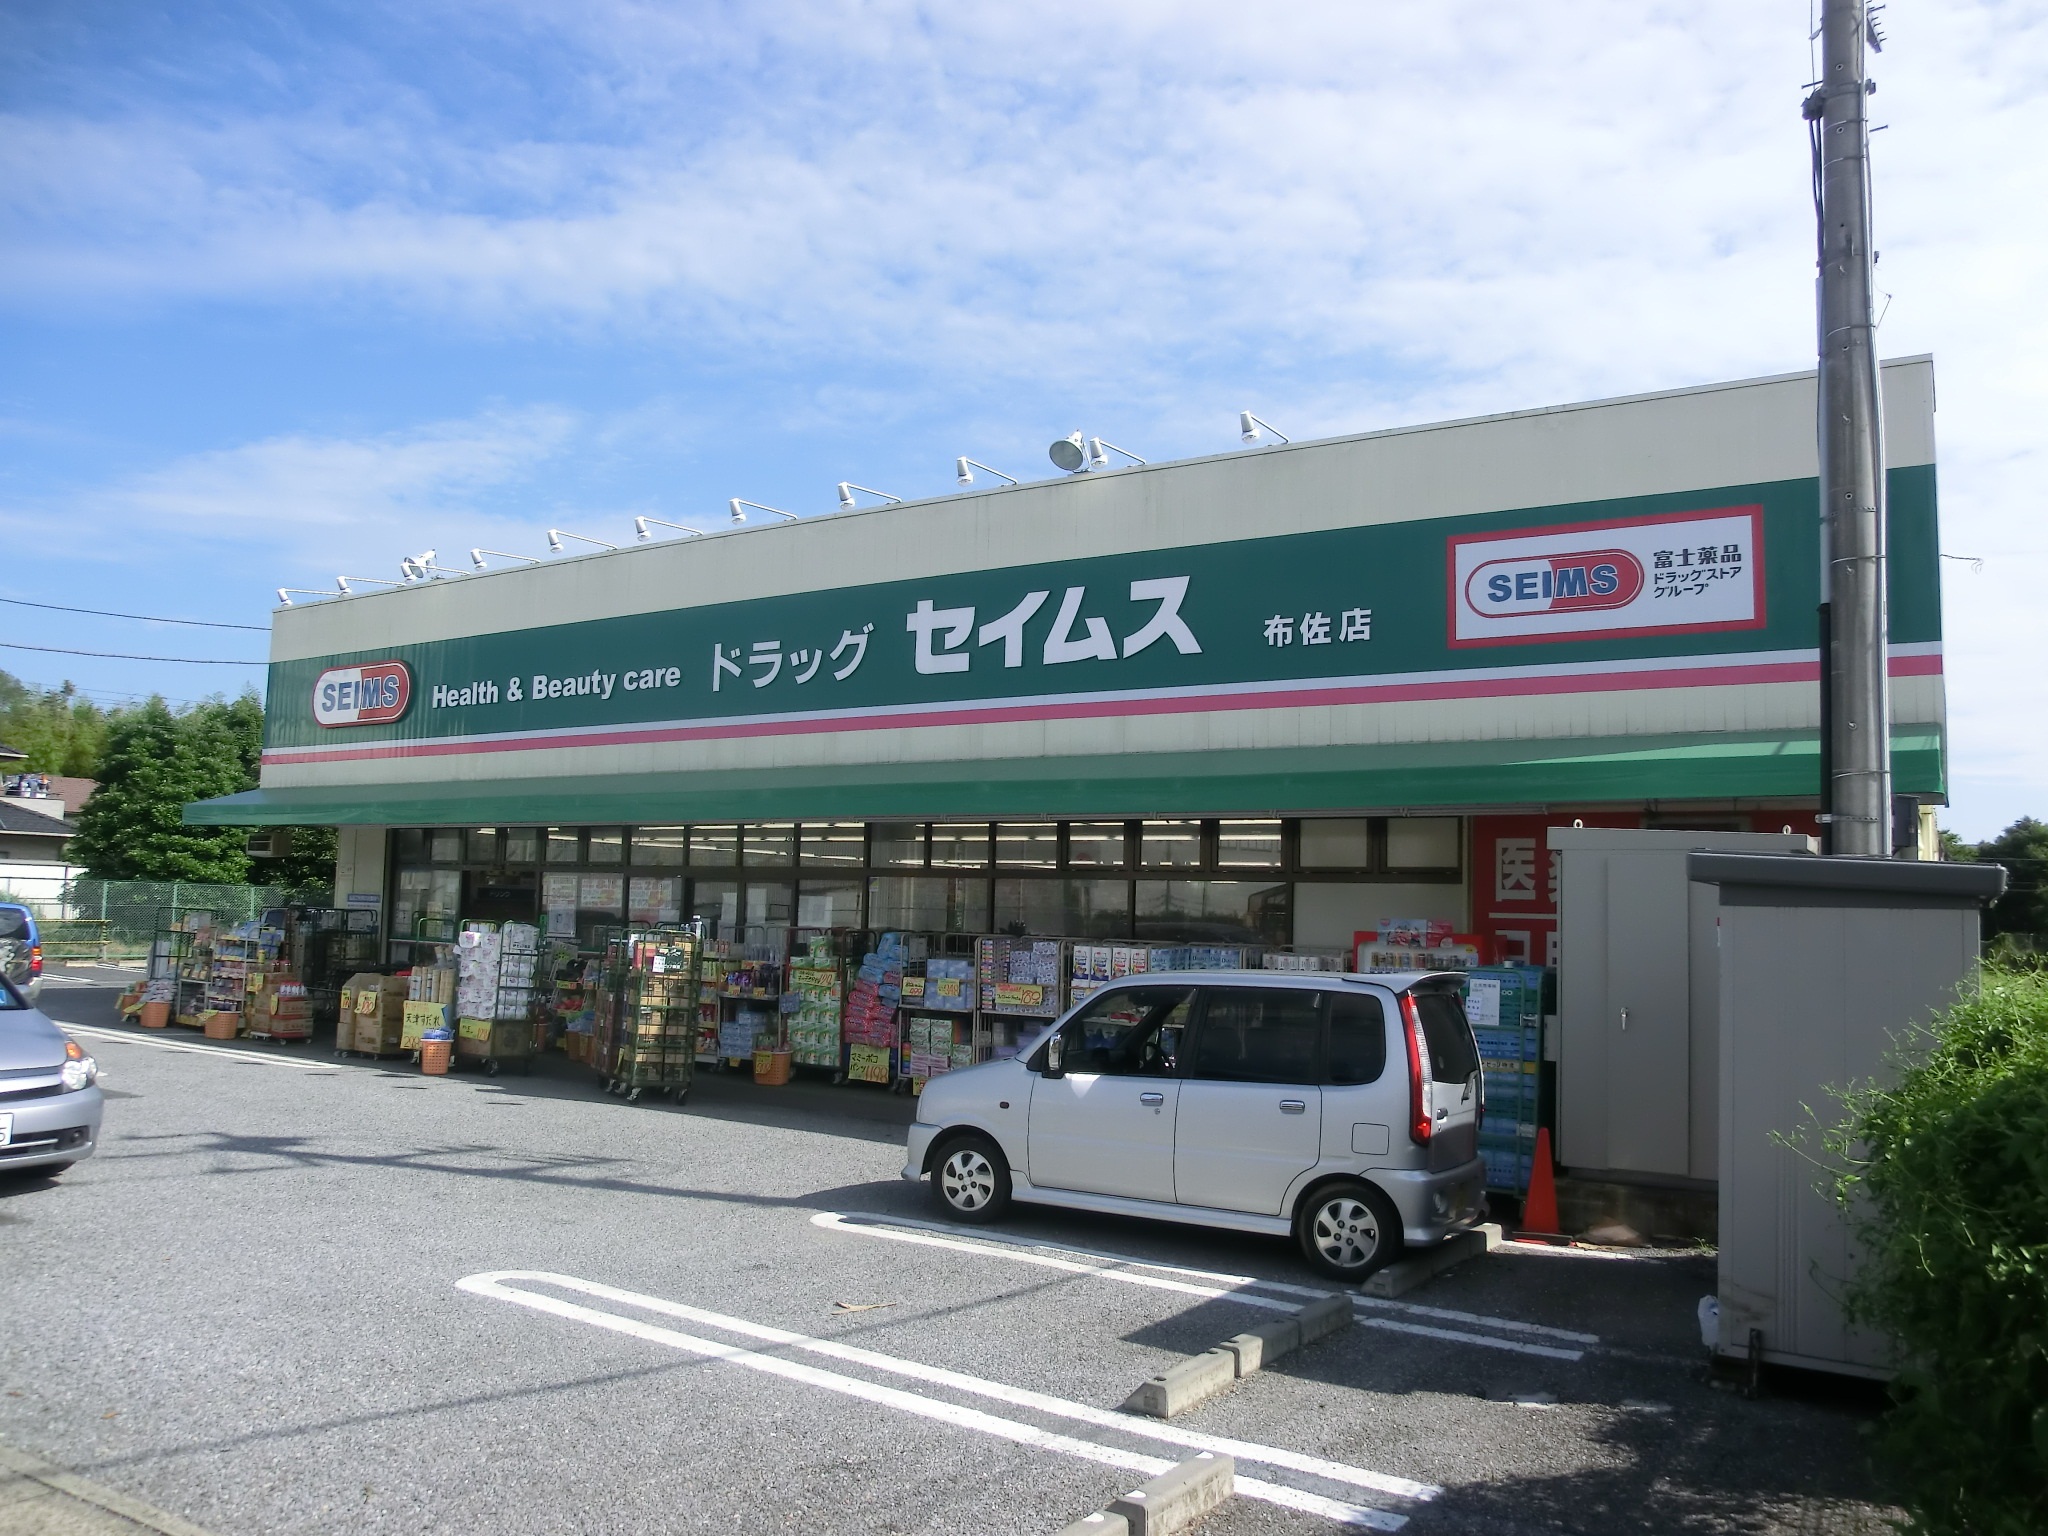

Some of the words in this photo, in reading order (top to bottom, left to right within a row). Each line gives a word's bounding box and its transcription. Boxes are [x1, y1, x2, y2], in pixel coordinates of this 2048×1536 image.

[1653, 544, 1742, 569] 富士薬品
[1487, 564, 1618, 602] SEIMS
[1654, 566, 1742, 585] ドラッグストア
[1654, 583, 1709, 599] グループ
[711, 622, 875, 693] ドラッグ
[906, 574, 1204, 676] セイムス
[1262, 606, 1373, 649] 布佐店
[321, 674, 400, 714] SEIMS
[432, 679, 499, 709] Health
[506, 677, 524, 702] &
[533, 669, 617, 700] Beauty
[623, 666, 681, 690] care
[851, 1052, 879, 1064] マミーポコ
